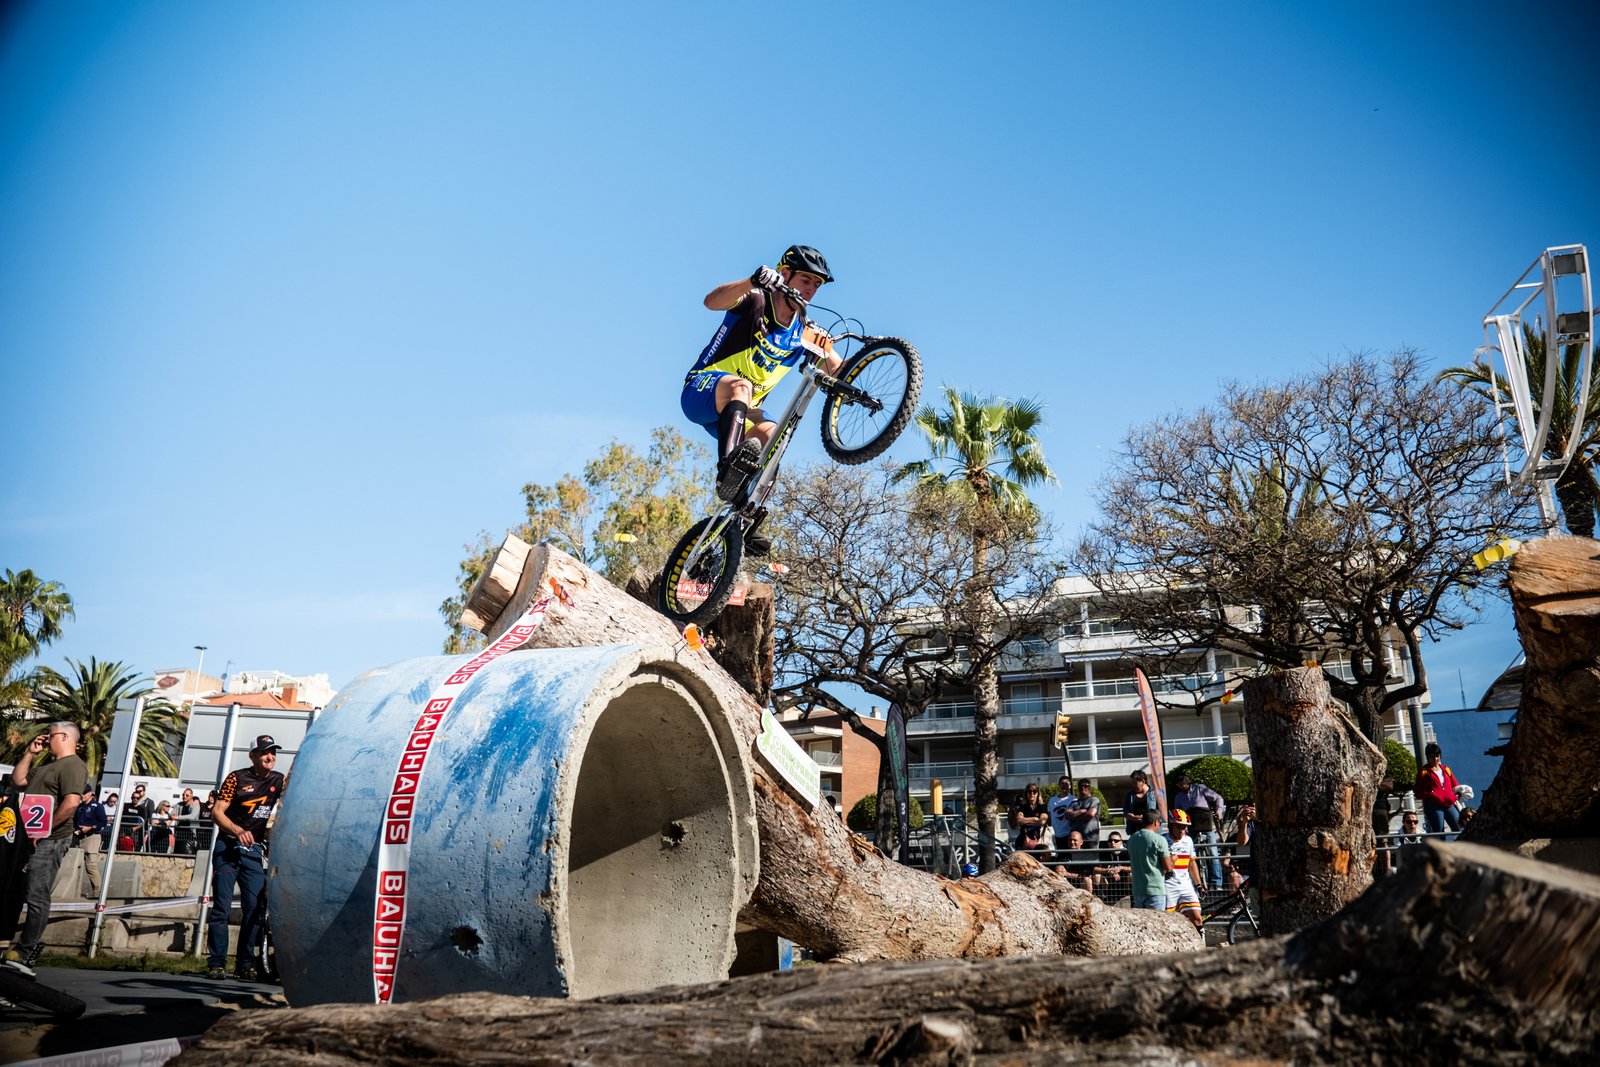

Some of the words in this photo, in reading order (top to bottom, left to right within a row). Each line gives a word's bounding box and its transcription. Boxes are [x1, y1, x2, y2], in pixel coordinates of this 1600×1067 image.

[813, 332, 827, 348] 10
[447, 625, 535, 684] BAUHAUS
[388, 699, 451, 842] BAUHAUS
[25, 805, 45, 828] 2
[375, 873, 404, 1003] BAUHA
